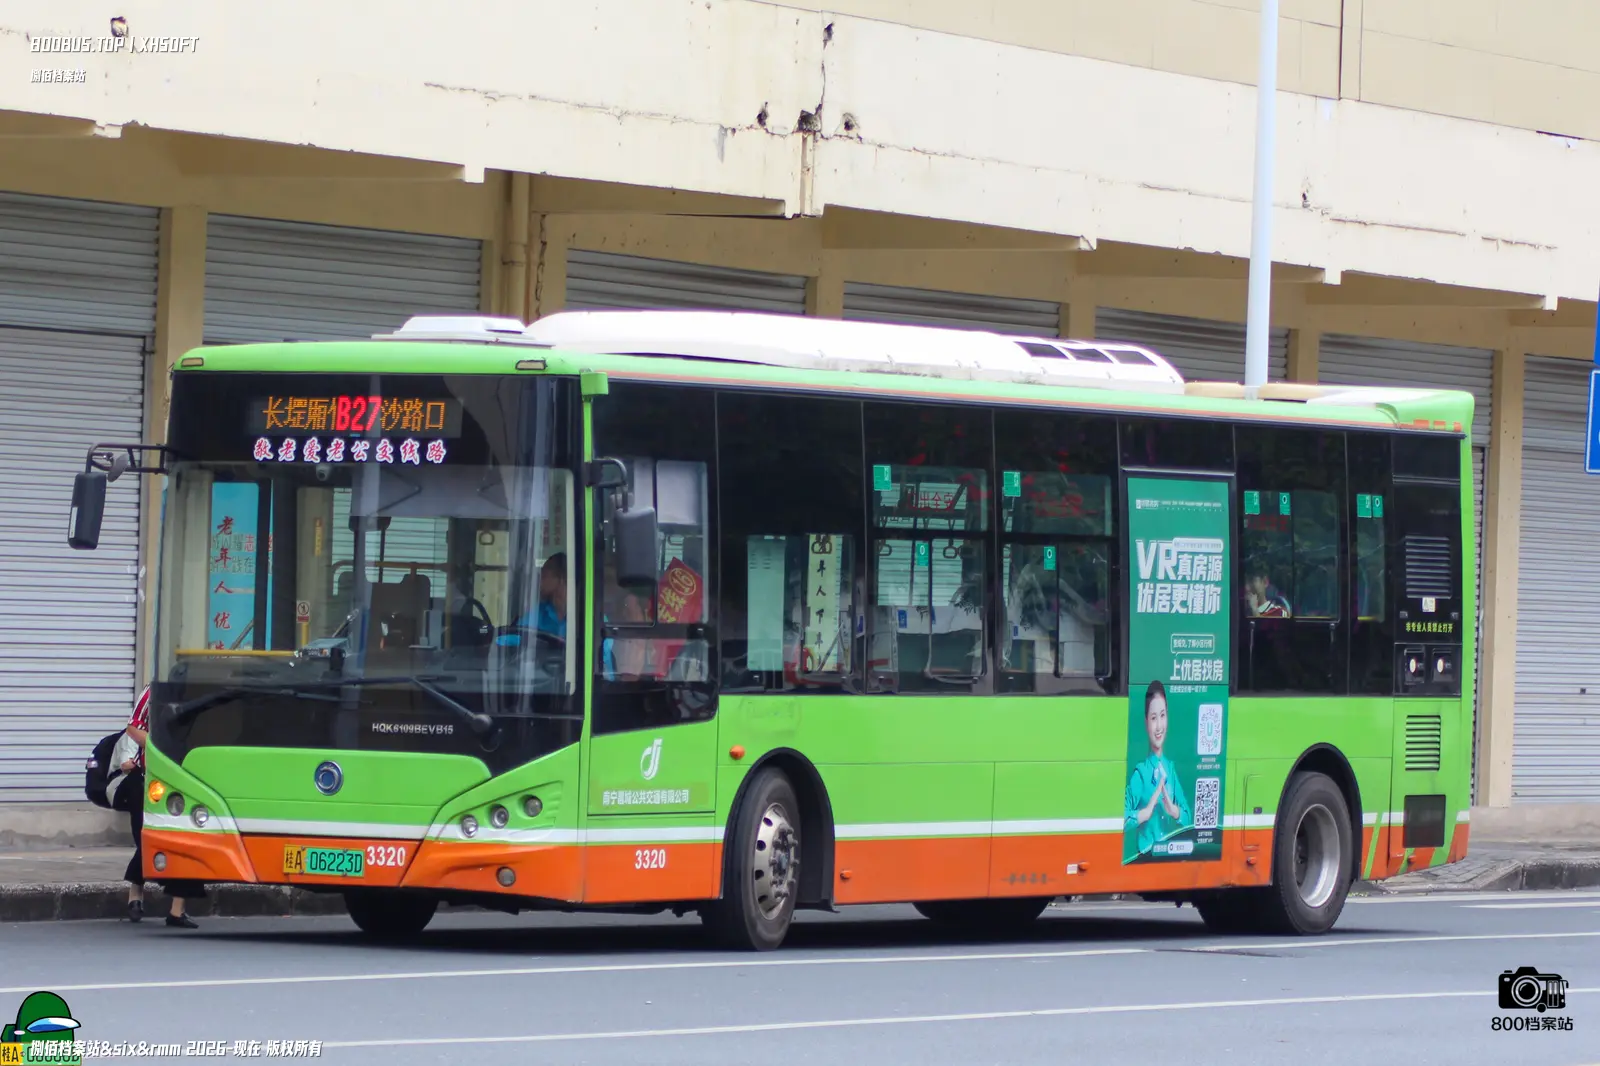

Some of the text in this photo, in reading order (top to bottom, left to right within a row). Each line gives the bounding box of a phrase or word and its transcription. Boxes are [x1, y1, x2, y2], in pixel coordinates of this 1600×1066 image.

[336, 396, 382, 431] B27
[1136, 582, 1222, 615] 优居更懂你
[1169, 658, 1223, 682] 上优居找房
[366, 845, 406, 867] 3320
[634, 848, 667, 870] 3320
